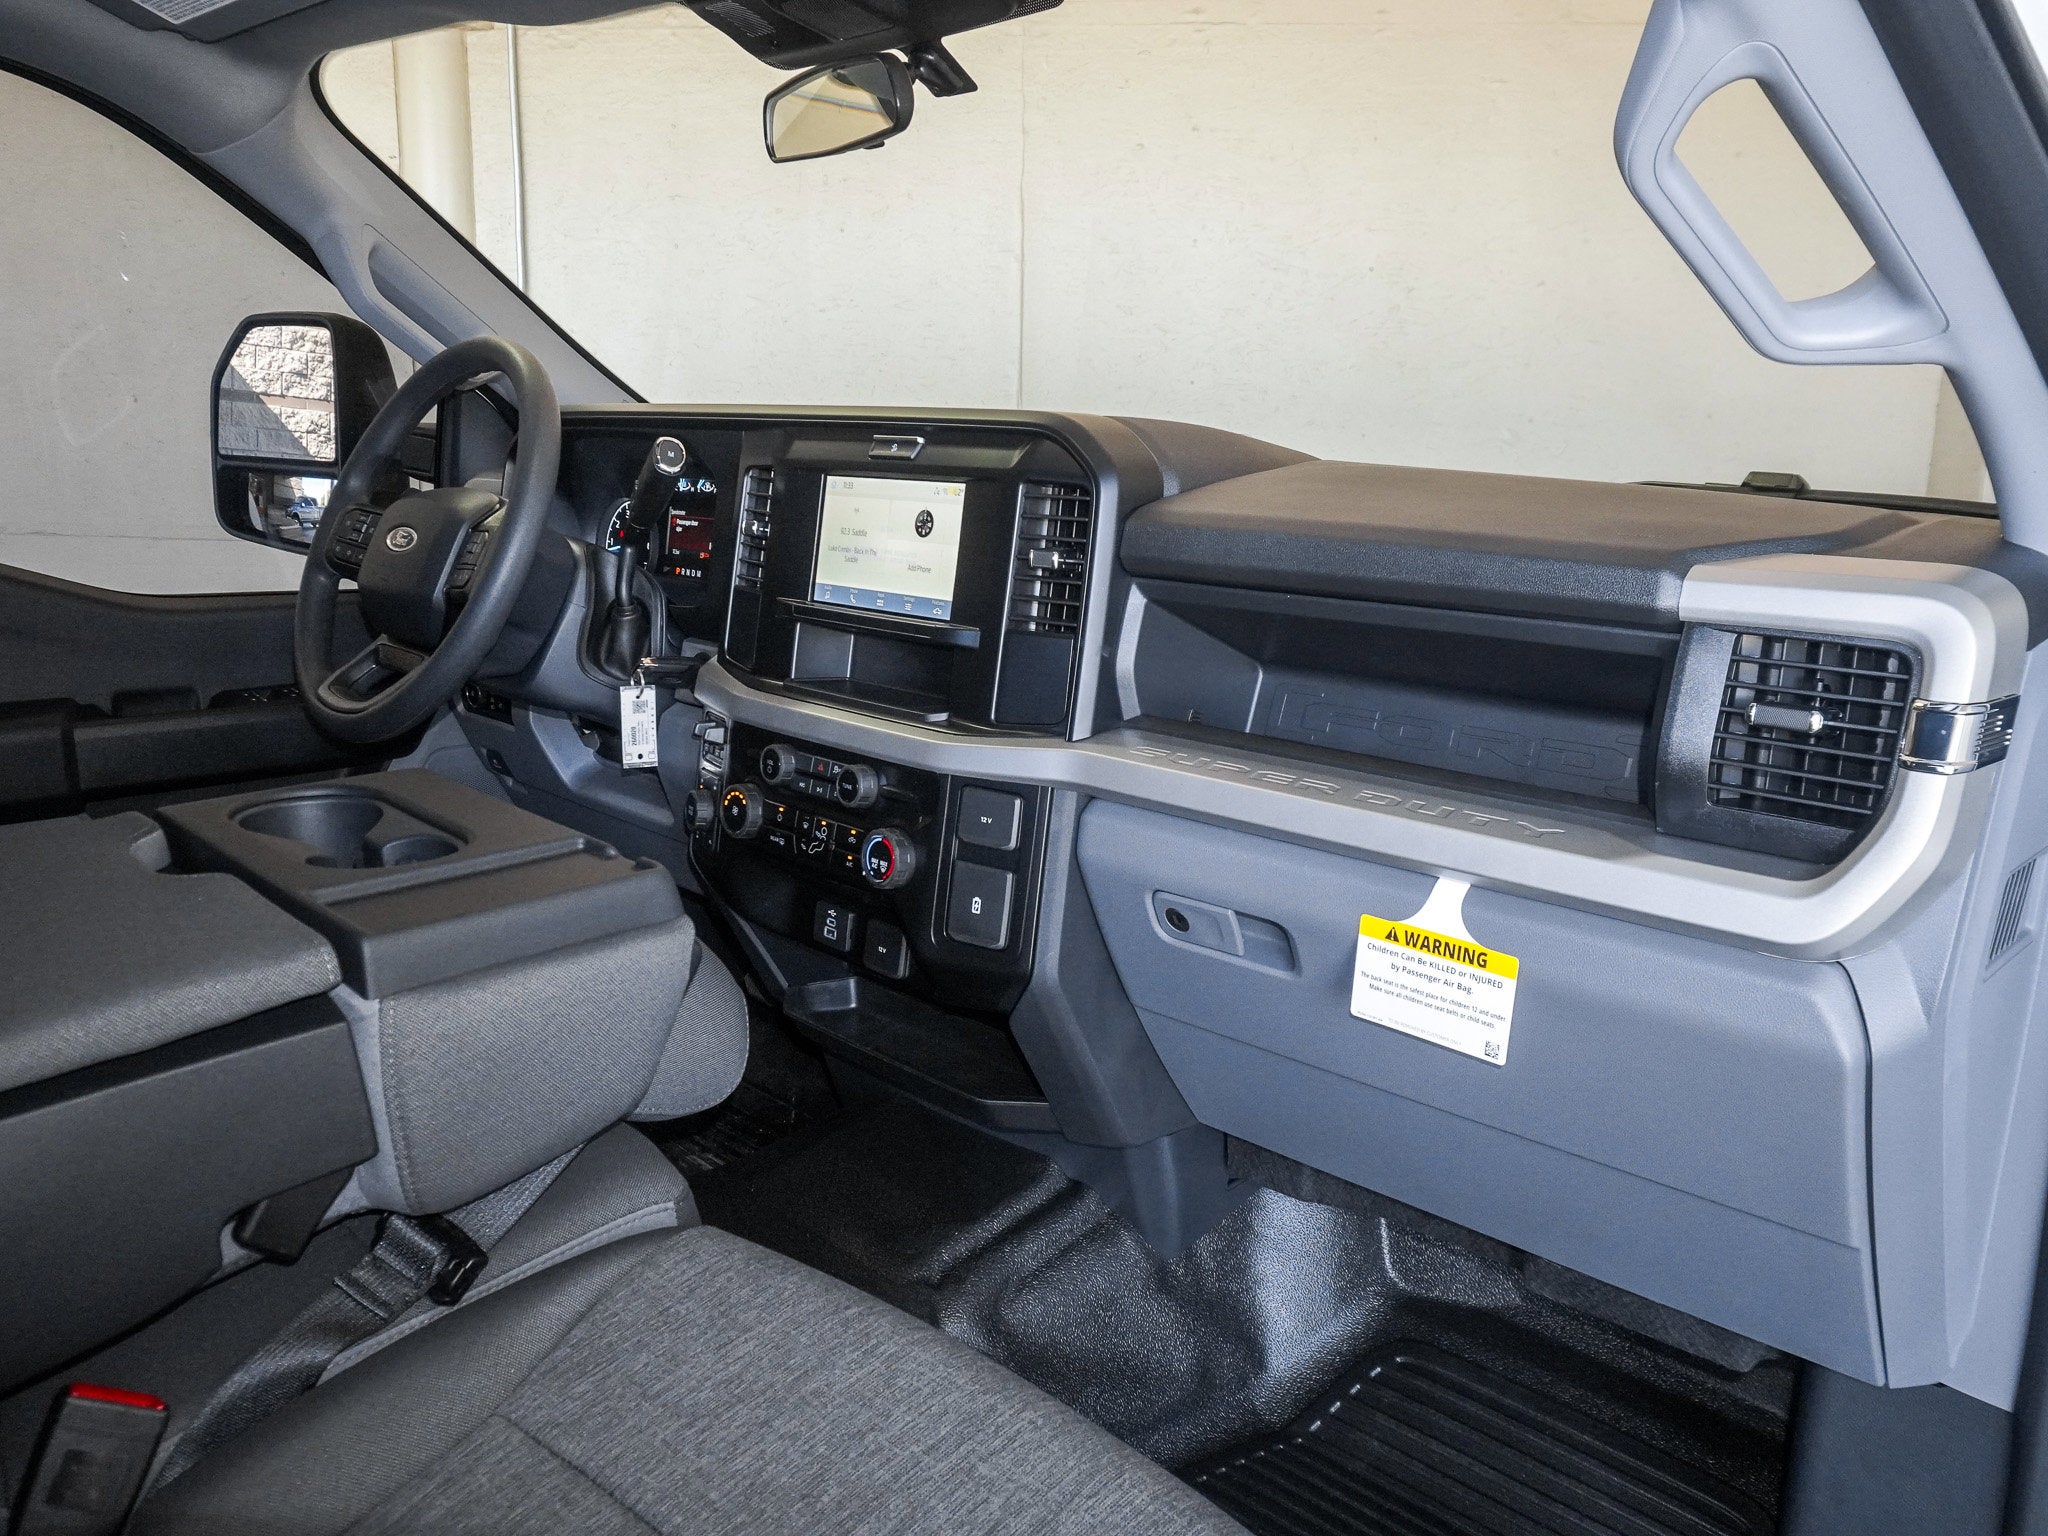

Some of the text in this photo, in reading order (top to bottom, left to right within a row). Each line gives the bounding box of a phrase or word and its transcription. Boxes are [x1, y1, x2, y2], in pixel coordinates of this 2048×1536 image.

[675, 567, 680, 575] P
[681, 567, 686, 576] R
[691, 569, 696, 577] D
[1130, 746, 1566, 838] SUPER DUTY
[1367, 942, 1399, 958] Children
[1400, 952, 1416, 962] Can
[1417, 957, 1428, 966] Be
[1429, 961, 1456, 975] KILLED
[1469, 973, 1503, 989] INJURED
[1404, 930, 1488, 968] WARNING
[1371, 974, 1382, 982] back
[1384, 978, 1394, 986] seat
[1410, 986, 1424, 996] safest
[1425, 992, 1438, 1000] place
[1448, 998, 1470, 1010] children
[1479, 1009, 1489, 1017] and
[1490, 1012, 1506, 1022] under
[1390, 962, 1474, 996] by Passenger Air Bag.
[1369, 983, 1382, 992] Make
[1402, 994, 1424, 1006] children
[1434, 1004, 1444, 1012] seat
[1446, 1008, 1458, 1017] belts
[1466, 1014, 1480, 1024] child
